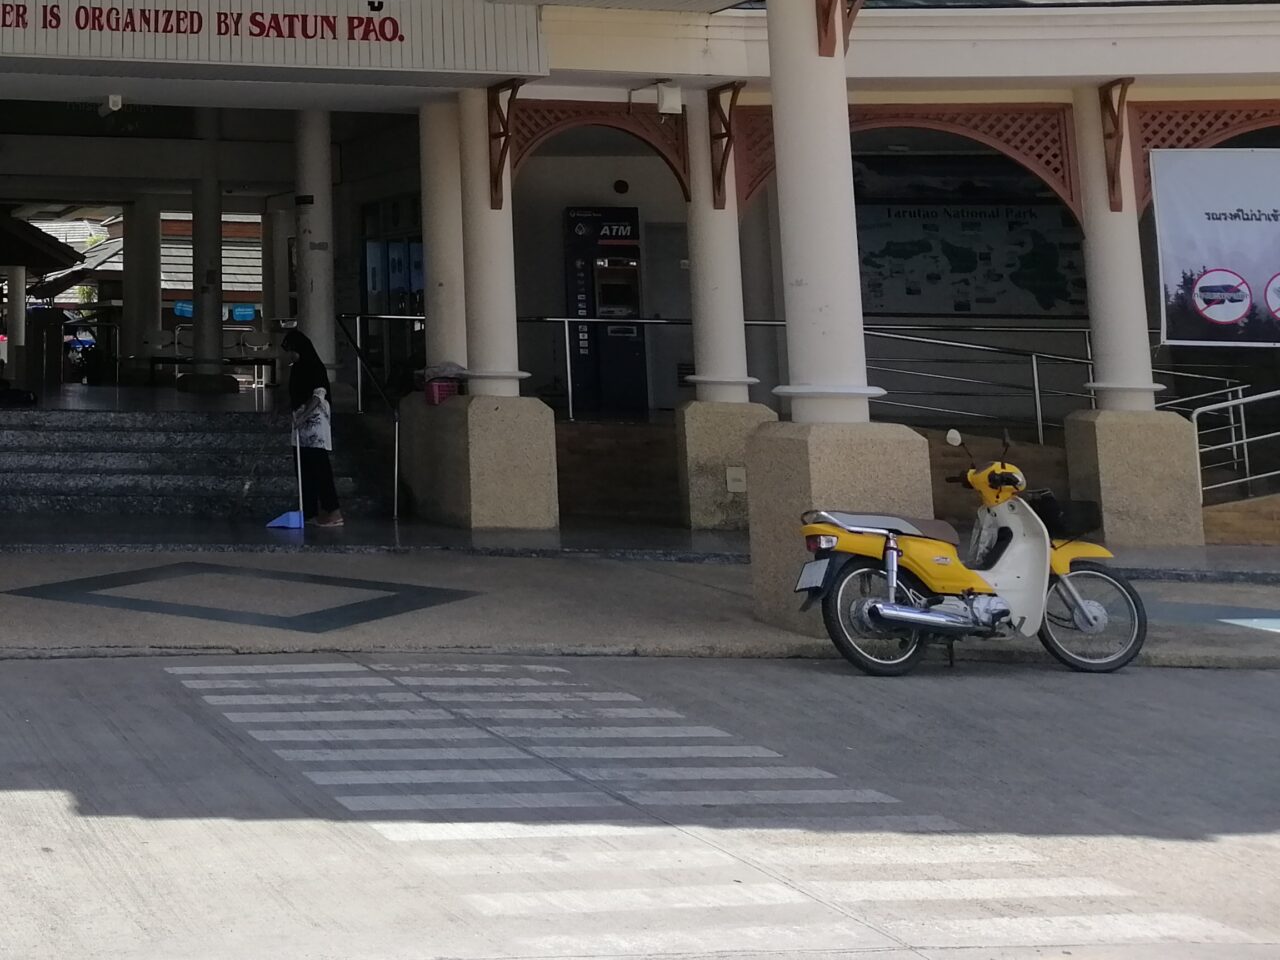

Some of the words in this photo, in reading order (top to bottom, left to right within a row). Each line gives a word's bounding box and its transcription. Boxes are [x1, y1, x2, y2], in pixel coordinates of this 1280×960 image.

[41, 4, 62, 30] IS
[75, 5, 203, 35] ORGANIZED
[216, 11, 243, 37] BY
[249, 11, 338, 40] SATUN
[346, 15, 405, 43] PAO.
[886, 207, 939, 220] Tarutao
[943, 207, 1000, 220] National
[1005, 207, 1039, 220] Park
[600, 225, 632, 236] ATM
